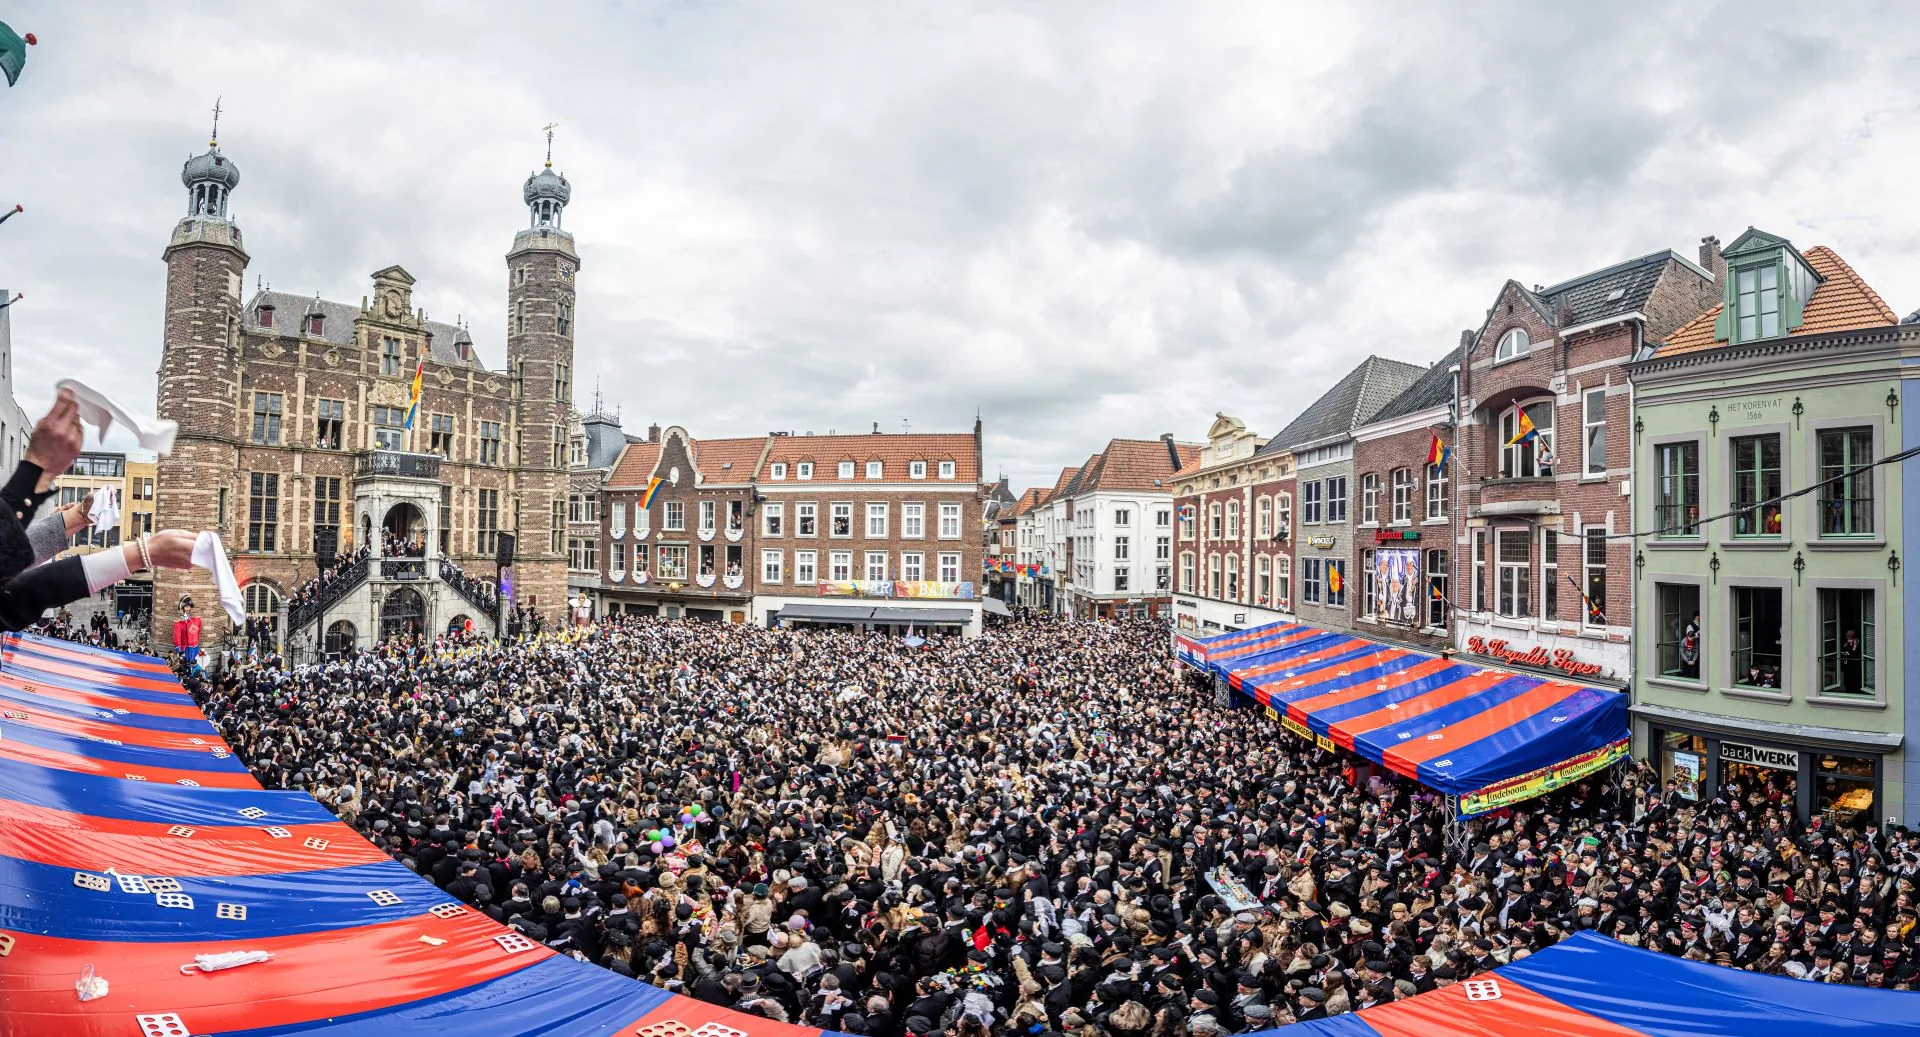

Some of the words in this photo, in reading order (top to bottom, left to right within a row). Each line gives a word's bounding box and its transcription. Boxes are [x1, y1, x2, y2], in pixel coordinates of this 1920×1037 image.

[1727, 403, 1742, 412] HET
[1743, 399, 1782, 410] KORENVAT
[1747, 411, 1762, 420] 1566
[1403, 531, 1418, 540] BIER
[919, 581, 949, 597] BAR
[1467, 635, 1487, 654] De
[1487, 638, 1550, 667] Vergulde
[1553, 647, 1602, 676] Gaper
[1282, 716, 1313, 739] HAMBURGERS
[1319, 736, 1332, 750] BAR
